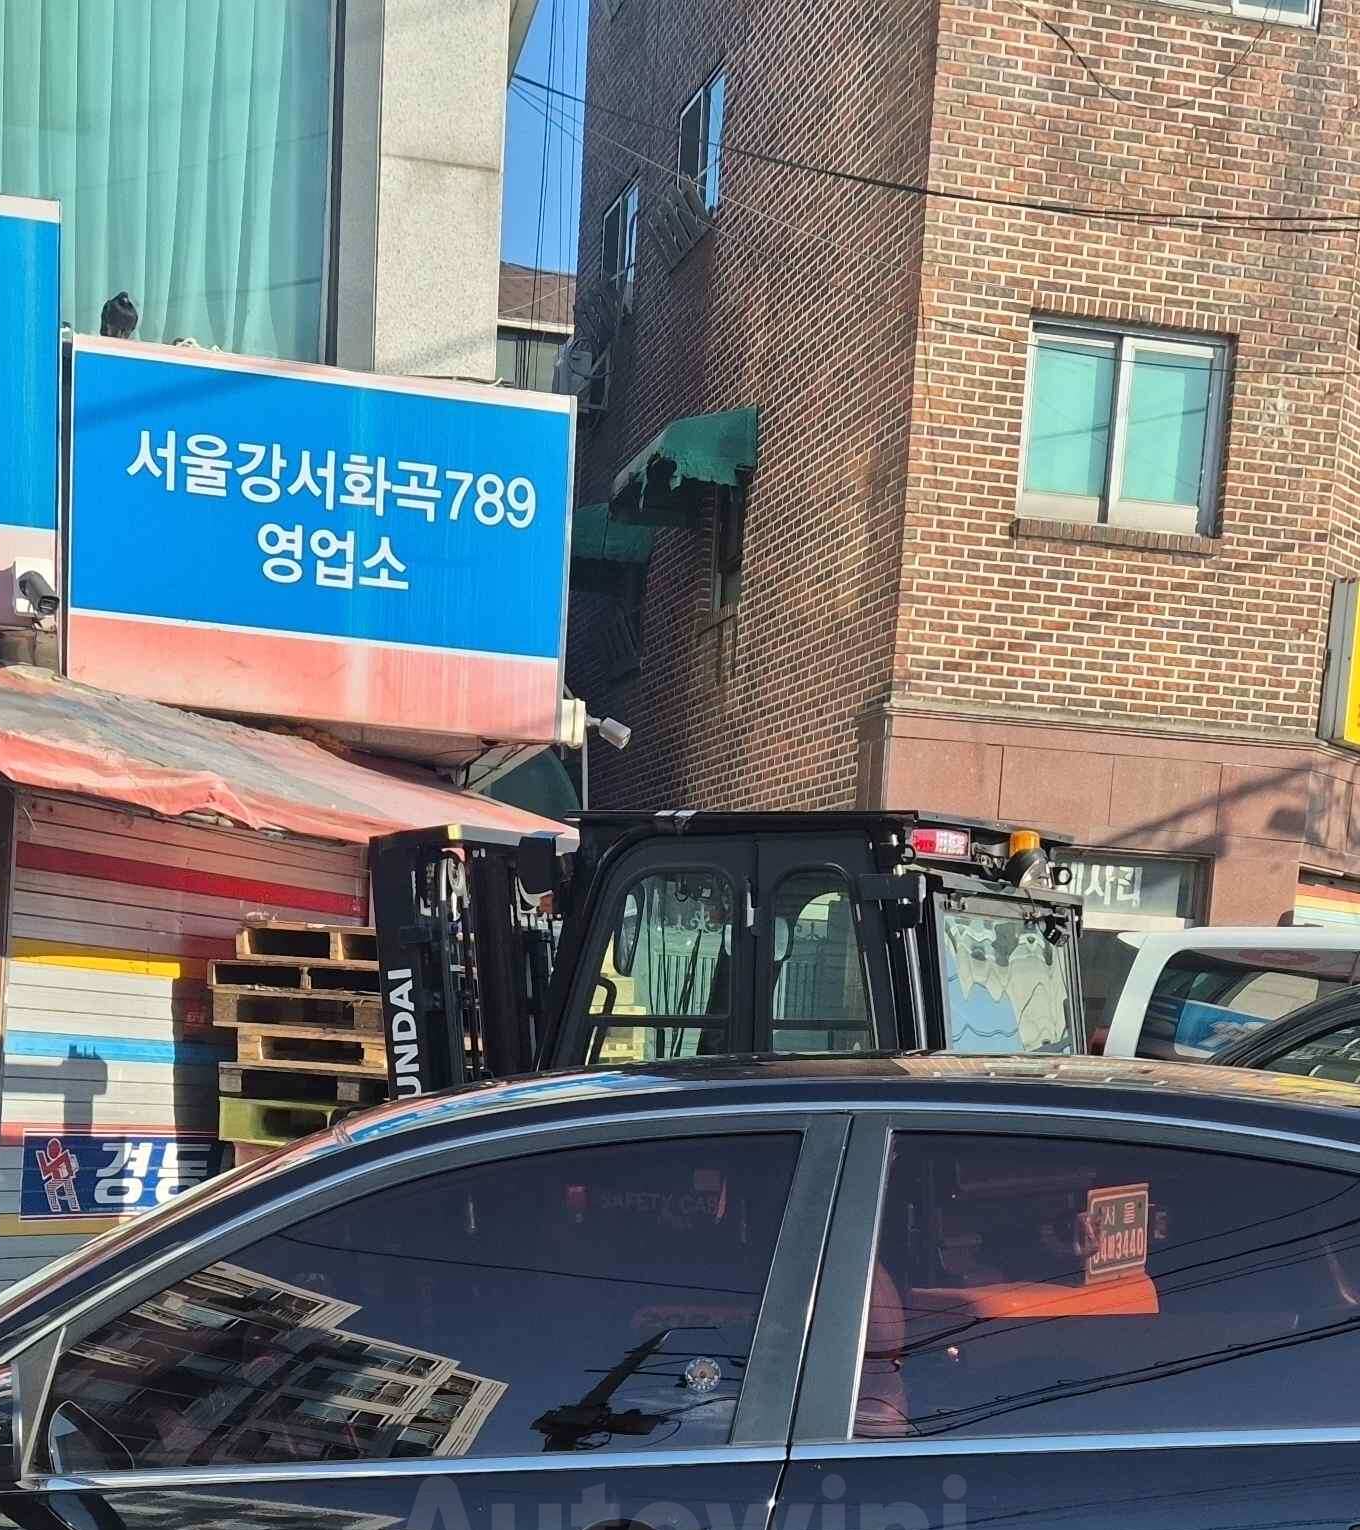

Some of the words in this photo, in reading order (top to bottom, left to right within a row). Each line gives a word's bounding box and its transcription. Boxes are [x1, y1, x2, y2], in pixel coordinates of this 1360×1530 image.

[126, 429, 537, 529] 서울강서화곡789
[257, 522, 410, 591] 영업소
[388, 967, 423, 1101] UNDAI
[93, 1142, 212, 1205] 경동
